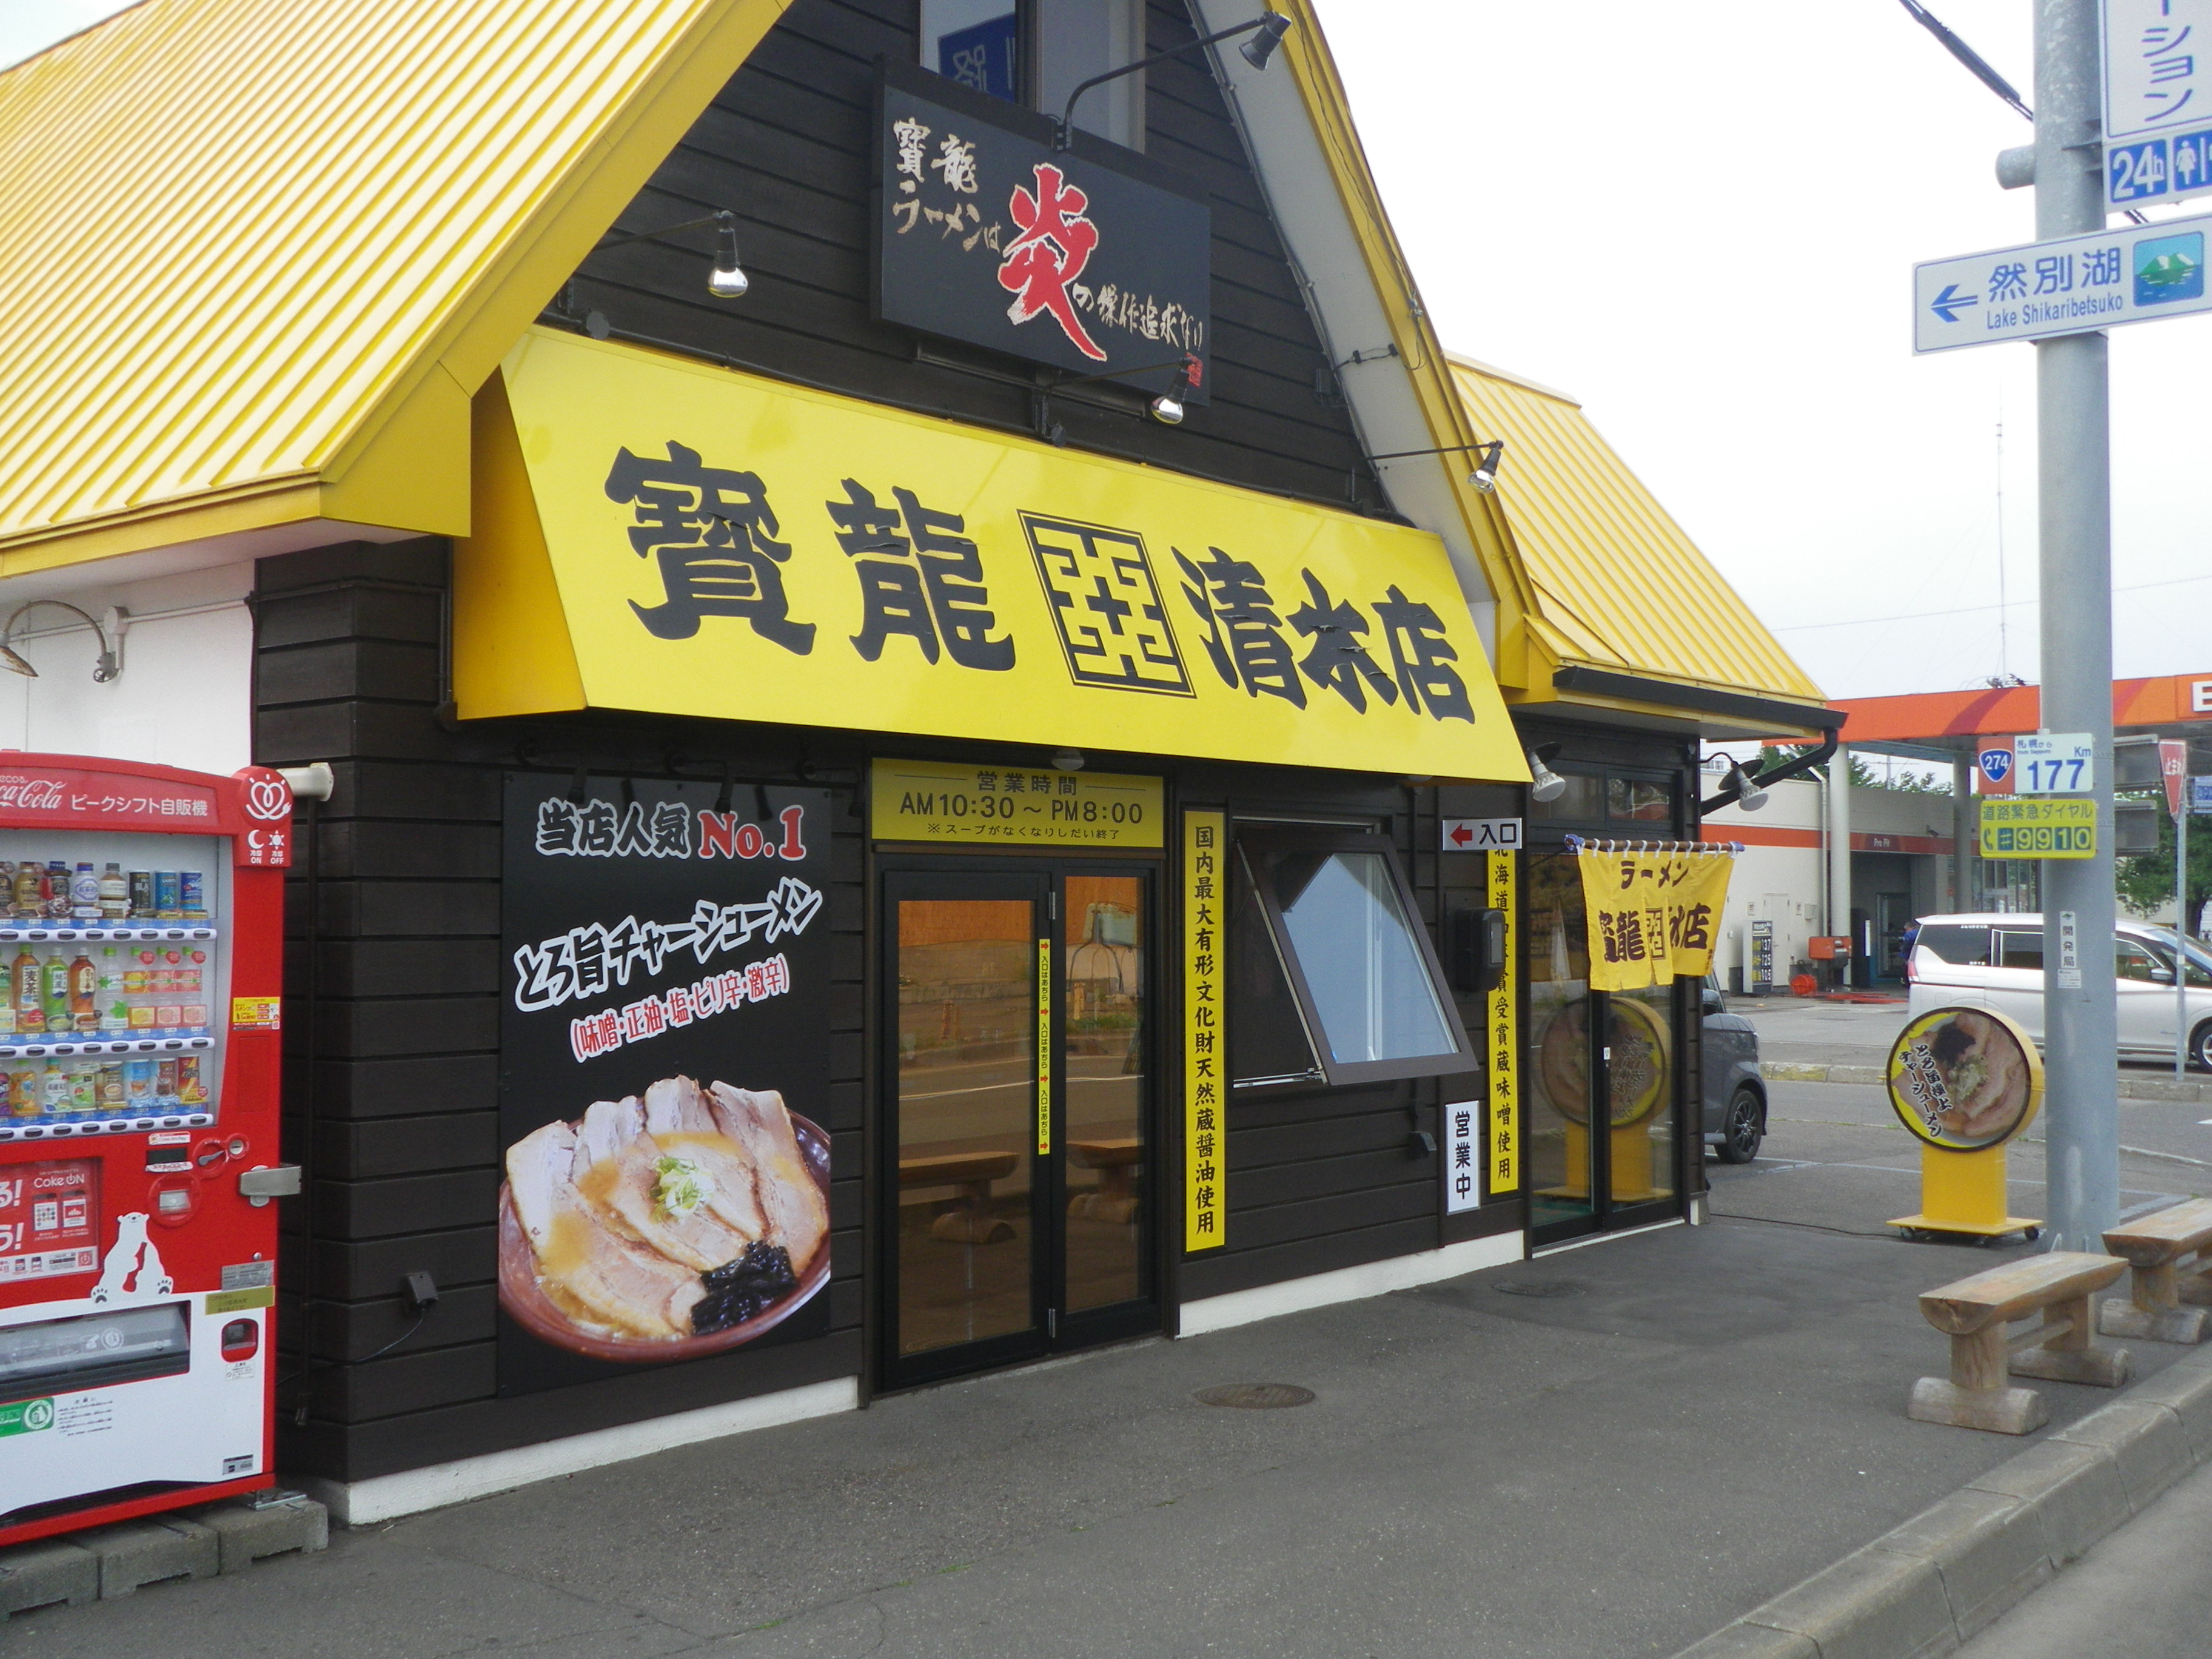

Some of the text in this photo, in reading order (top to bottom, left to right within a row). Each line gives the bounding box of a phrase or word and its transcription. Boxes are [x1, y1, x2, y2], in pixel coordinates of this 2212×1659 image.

[893, 116, 979, 194] 寶龍
[1988, 247, 2121, 303] 然別湖
[1987, 291, 2123, 330] Lake Shikaribetsuko
[1985, 754, 2009, 771] 274
[2074, 746, 2091, 757] Km
[976, 771, 1078, 796] 営業時間
[2027, 759, 2085, 791] 177
[71, 793, 208, 817] ピークシフト自販機
[1982, 803, 2093, 820] 道路緊急ダイヤル
[535, 797, 806, 861] 当店人気 No.1
[1480, 823, 1517, 845] 入口
[1620, 860, 1689, 890] ラーメン
[2062, 925, 2074, 967] 開発局
[1194, 826, 1216, 1235] 国内最大有形文化財天然蔵醤油使用
[1455, 1110, 1470, 1200] 営業中
[33, 1173, 84, 1188] Coke ON
